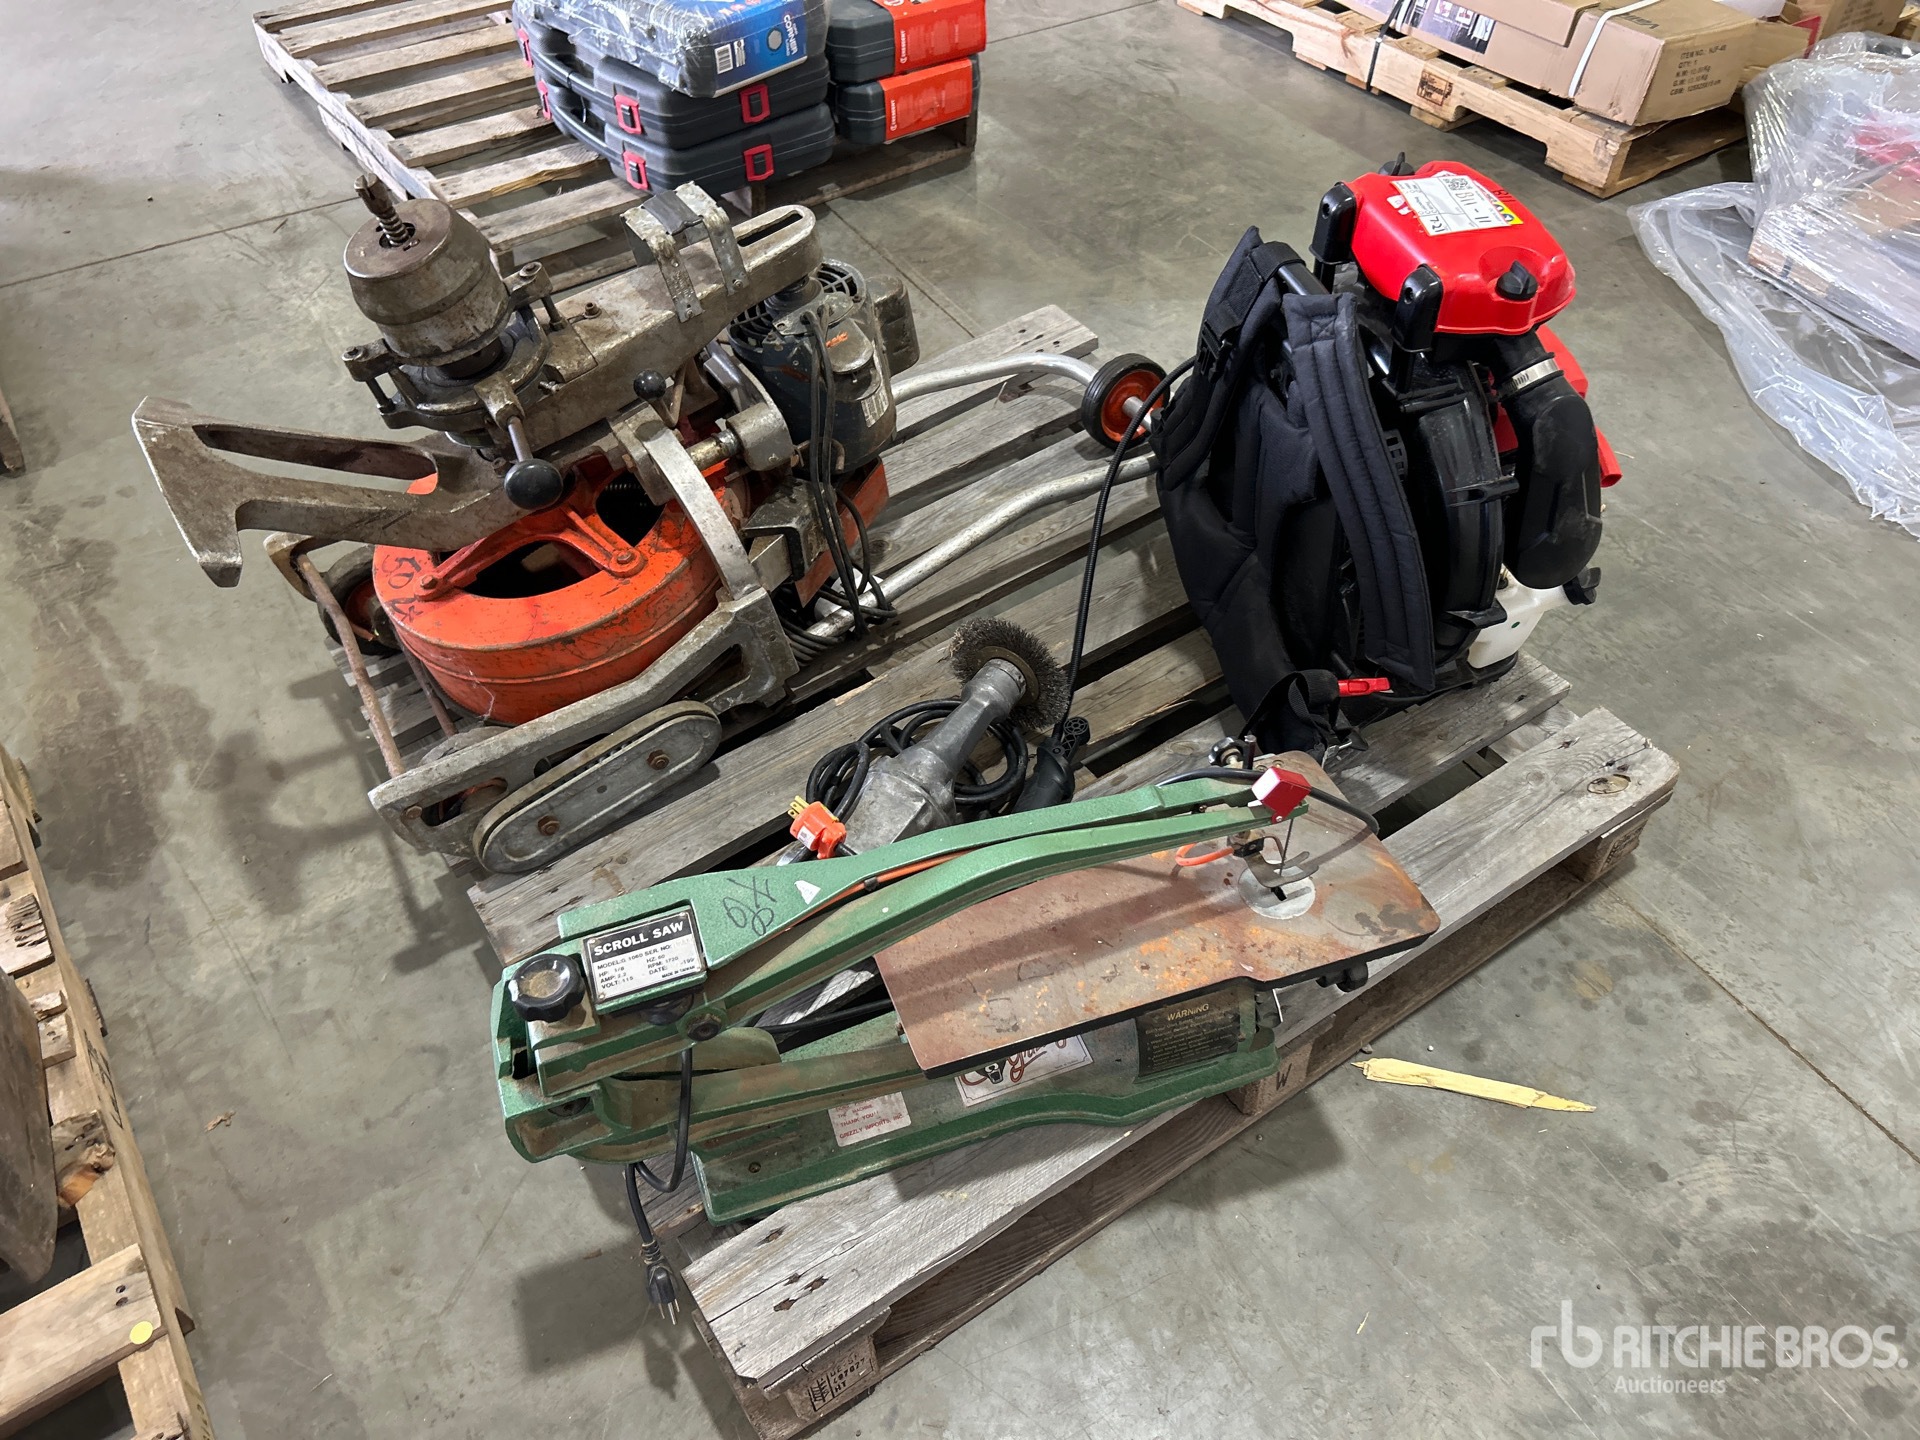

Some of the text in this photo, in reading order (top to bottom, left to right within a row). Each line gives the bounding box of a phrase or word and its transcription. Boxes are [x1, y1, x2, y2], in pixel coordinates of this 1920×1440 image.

[784, 14, 799, 56] CORNER
[594, 933, 649, 956] SCROLL
[652, 921, 684, 939] SAW
[1167, 1003, 1210, 1022] WARNING
[840, 1118, 860, 1127] THANK
[839, 1127, 863, 1139] GRIZZLY
